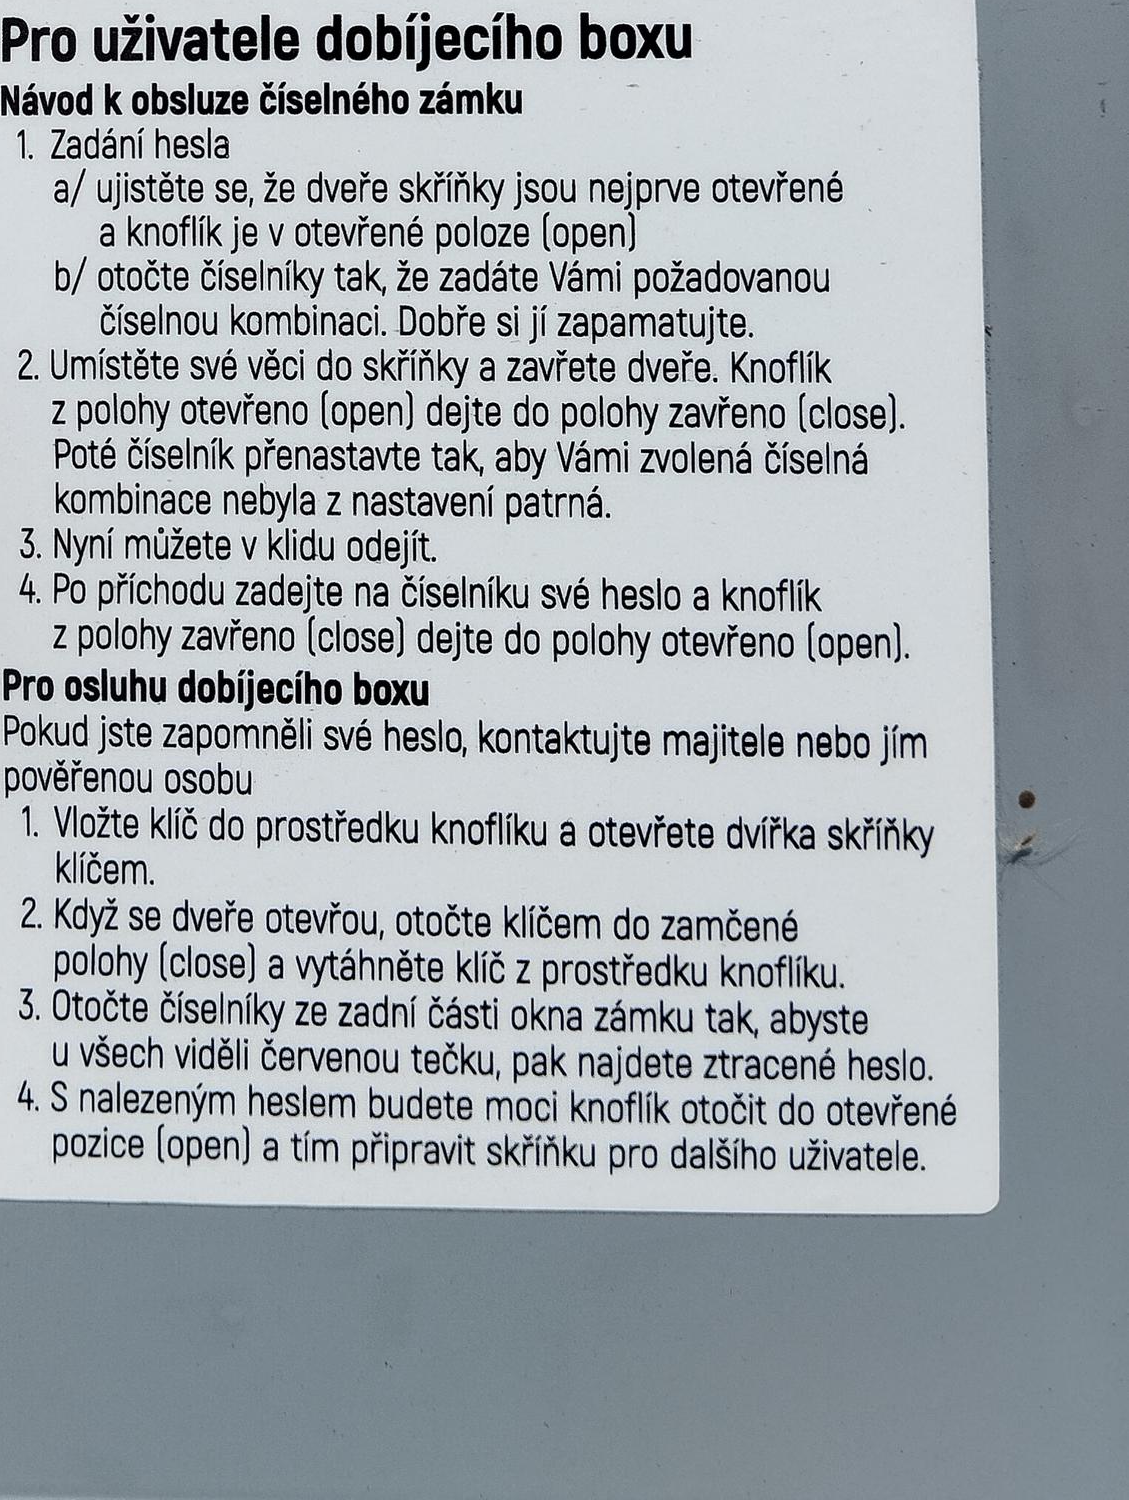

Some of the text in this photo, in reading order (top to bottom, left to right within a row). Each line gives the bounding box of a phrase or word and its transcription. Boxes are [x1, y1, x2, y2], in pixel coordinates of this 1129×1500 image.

[1, 11, 693, 73] Pro uživatele dobíjecího boxu
[0, 80, 523, 117] Návod k obsluze číselného zámku
[16, 126, 231, 161] 1. Zadání hesla
[53, 167, 844, 211] a/ ujistěte se, že dveře skříňky jsou nejprve otevřené
[19, 526, 437, 570] 3. Nyní můžete v klidu odejít.
[2, 667, 430, 713] Pro osluhu dobíjecího boxu
[4, 758, 253, 800] pověřenou osobu
[55, 850, 155, 886] klíčem.
[52, 1123, 926, 1176] pozice (open) a tím připravit skříňku pro dalšího uživatele.
